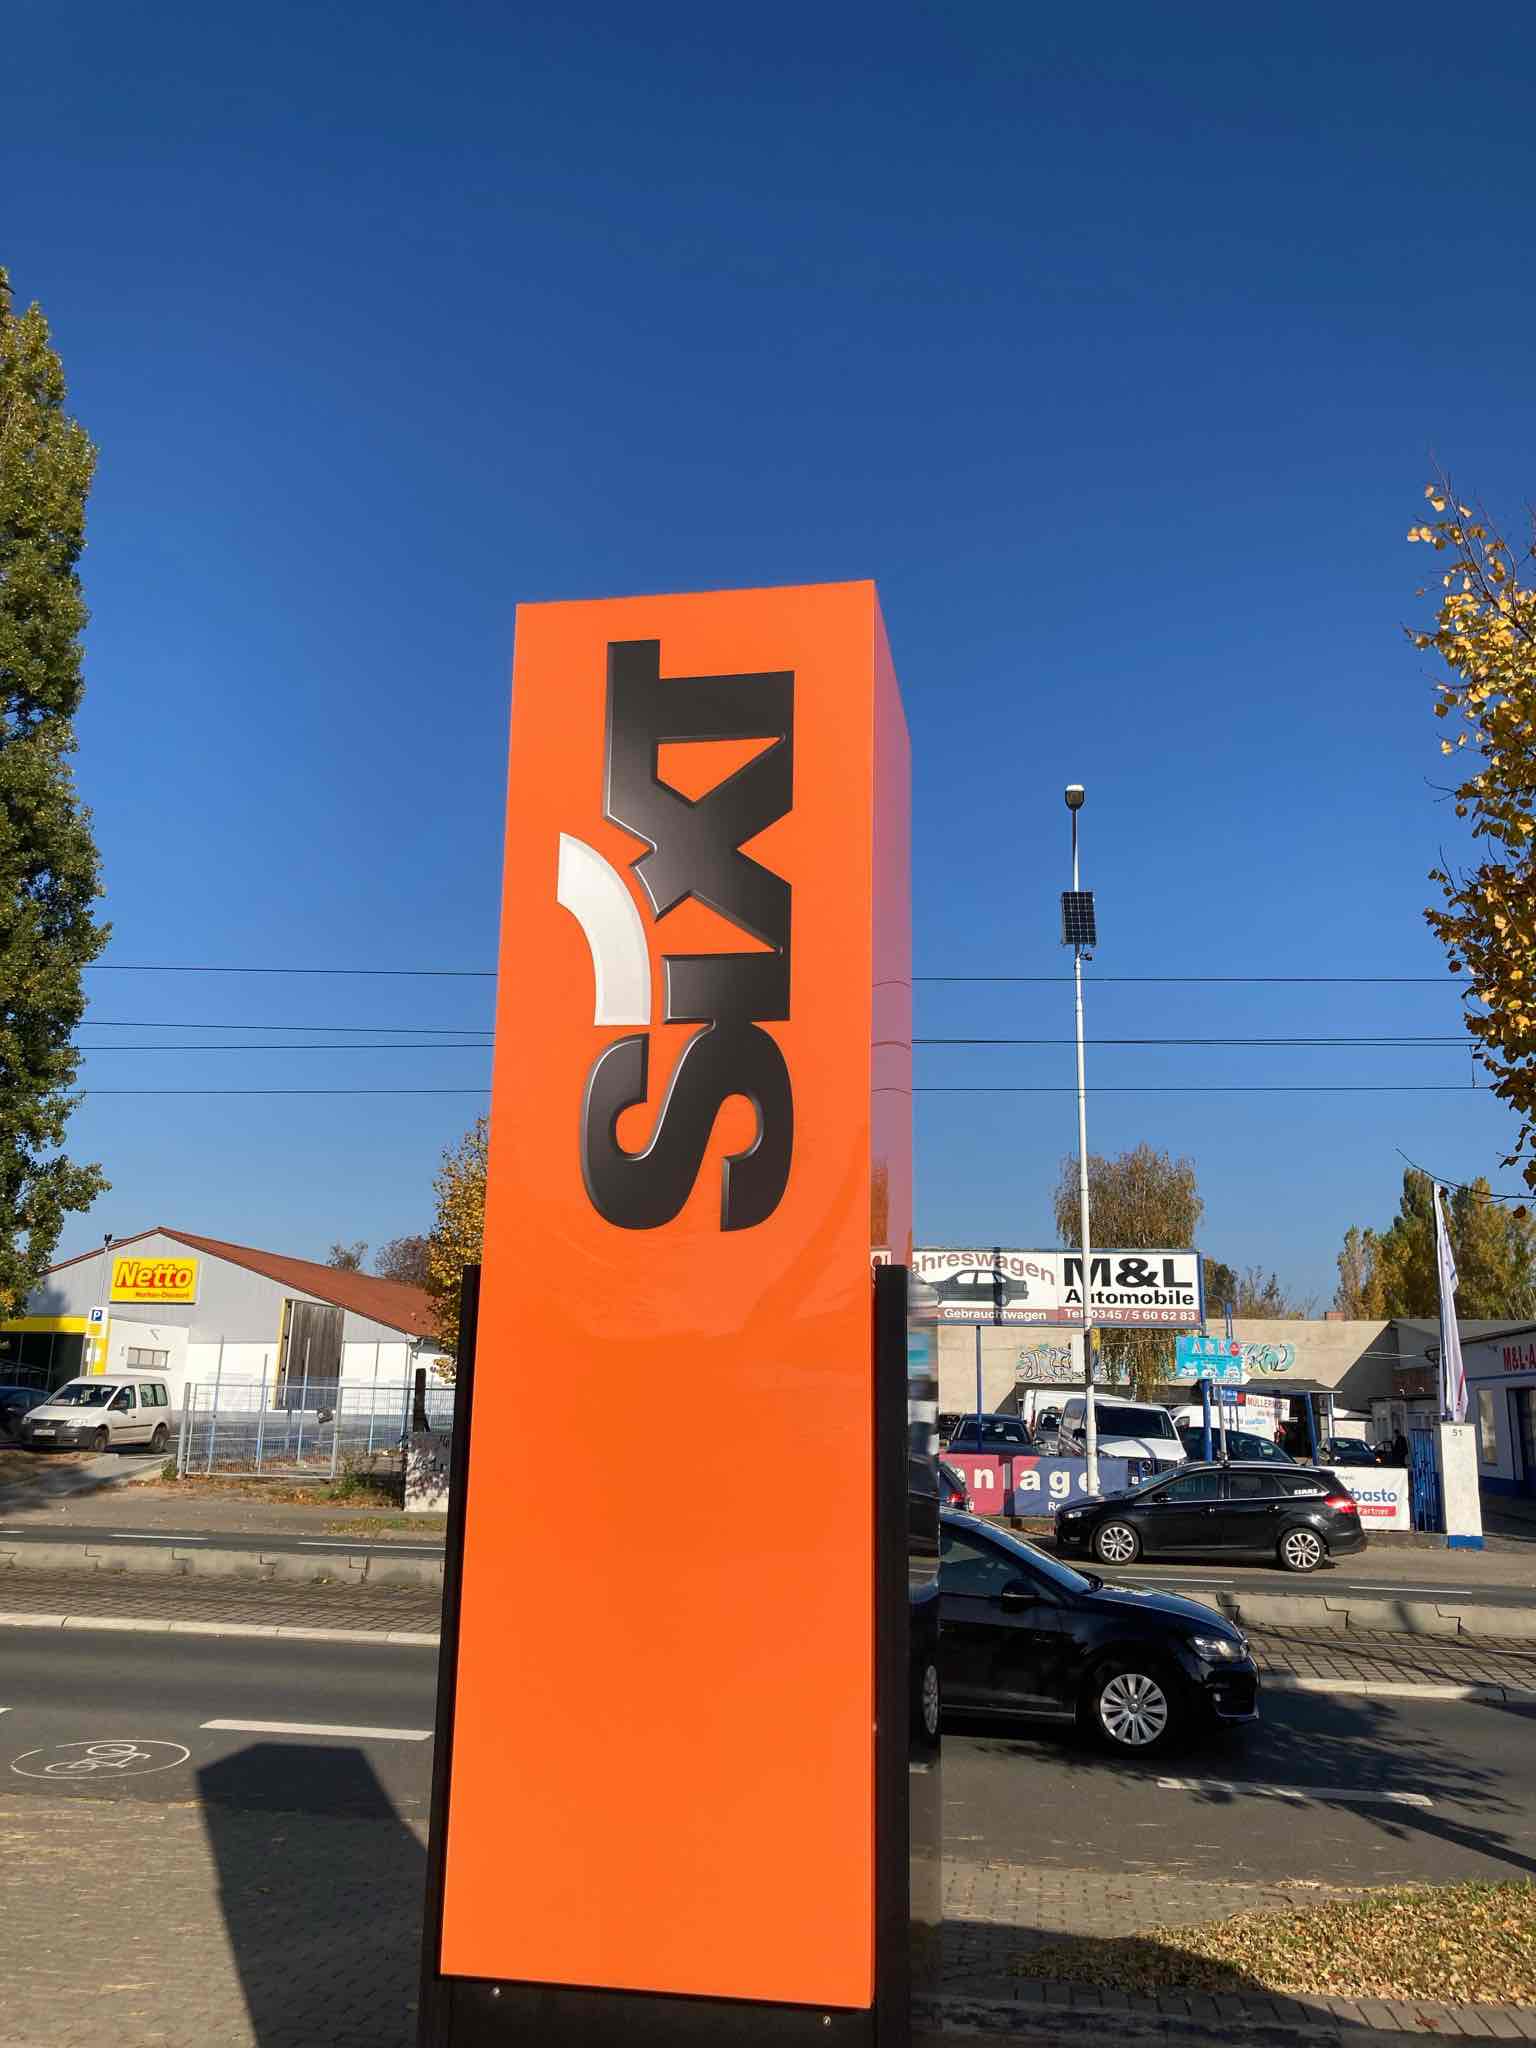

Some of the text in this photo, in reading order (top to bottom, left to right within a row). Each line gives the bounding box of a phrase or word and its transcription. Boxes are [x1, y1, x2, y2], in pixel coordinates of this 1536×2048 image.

[115, 1261, 193, 1289] Netto
[1063, 1257, 1193, 1288] M&L
[1090, 1310, 1122, 1320] 0345
[1143, 1310, 1158, 1321] 60
[1161, 1311, 1177, 1321] 62
[1180, 1311, 1196, 1321] 83
